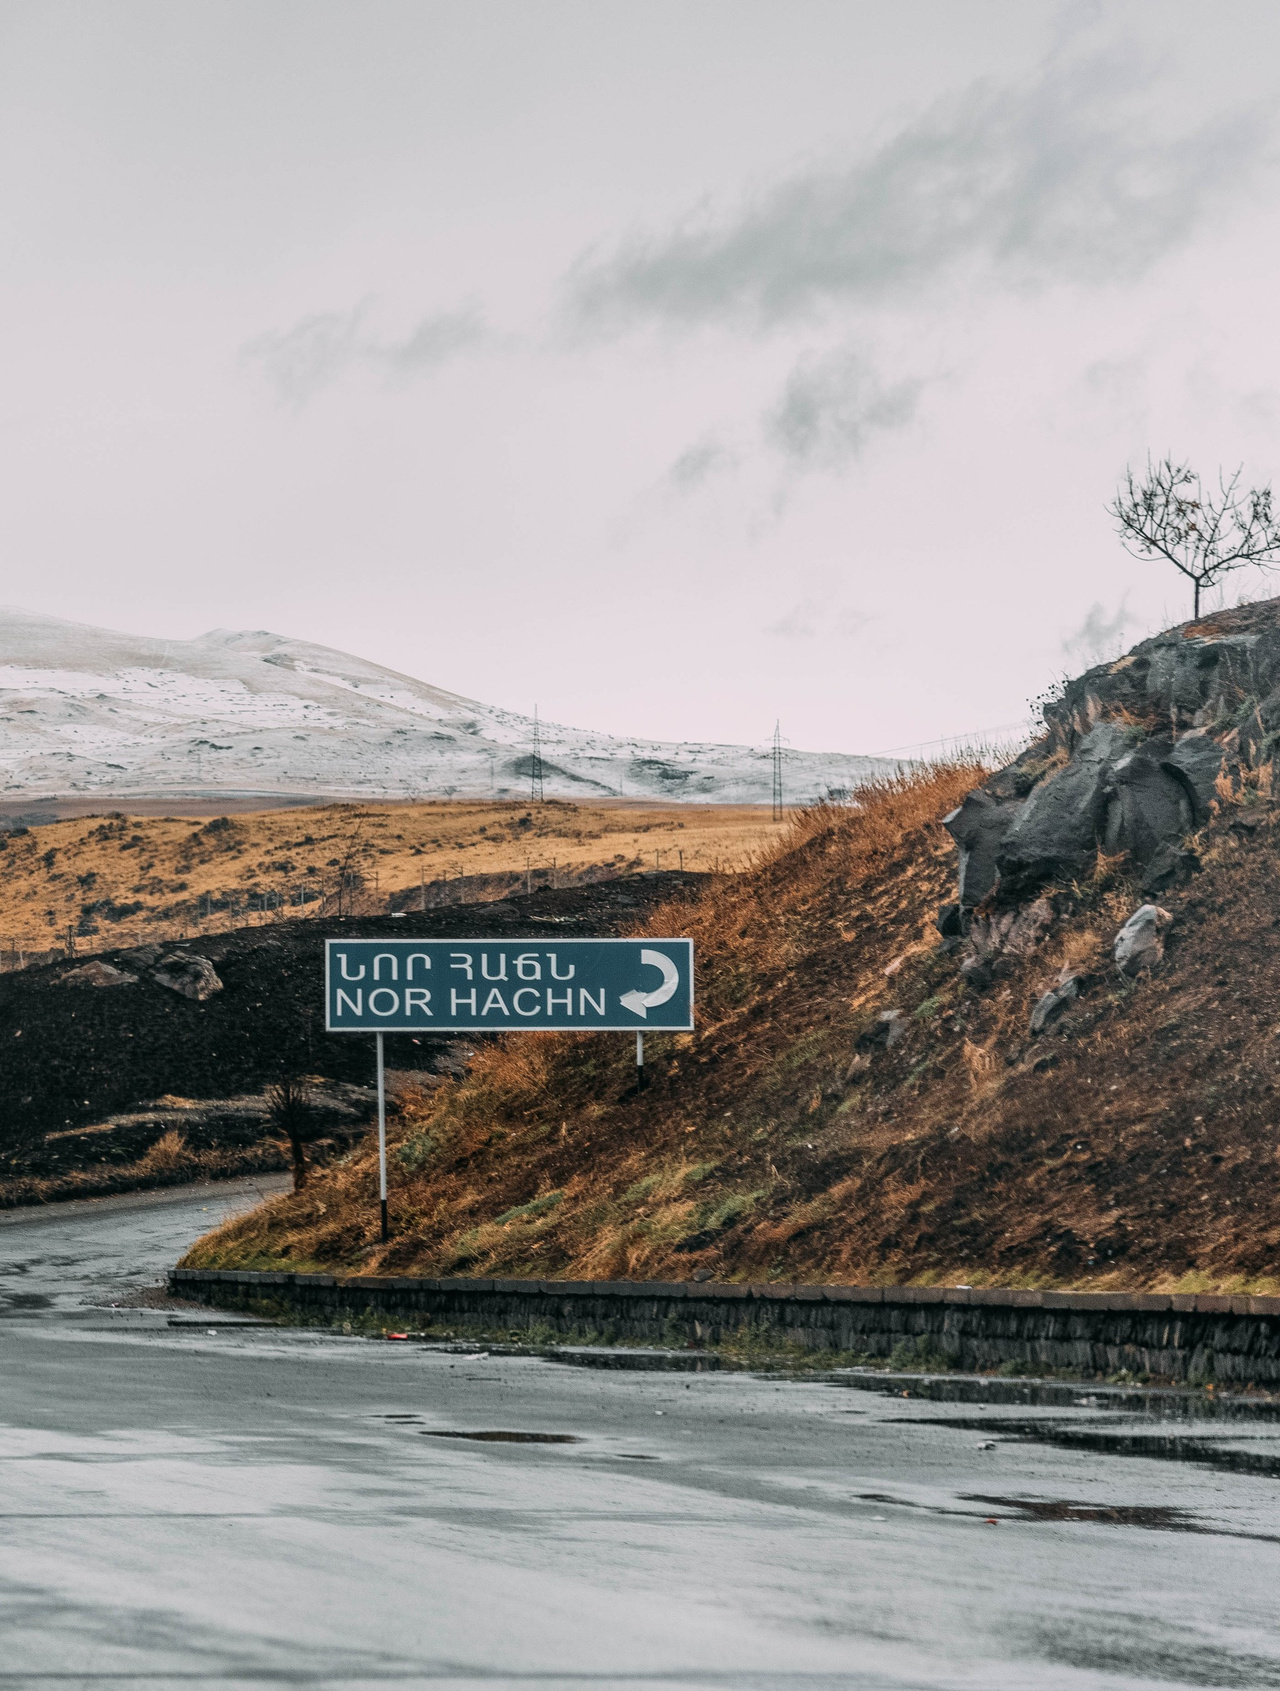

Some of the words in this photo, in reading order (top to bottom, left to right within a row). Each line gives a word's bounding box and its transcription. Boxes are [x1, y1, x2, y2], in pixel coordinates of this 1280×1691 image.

[336, 953, 431, 980] ՆՈՐ
[450, 953, 575, 981] ՀԱՃՆ
[336, 987, 433, 1016] NOR
[450, 987, 606, 1016] HACHN
